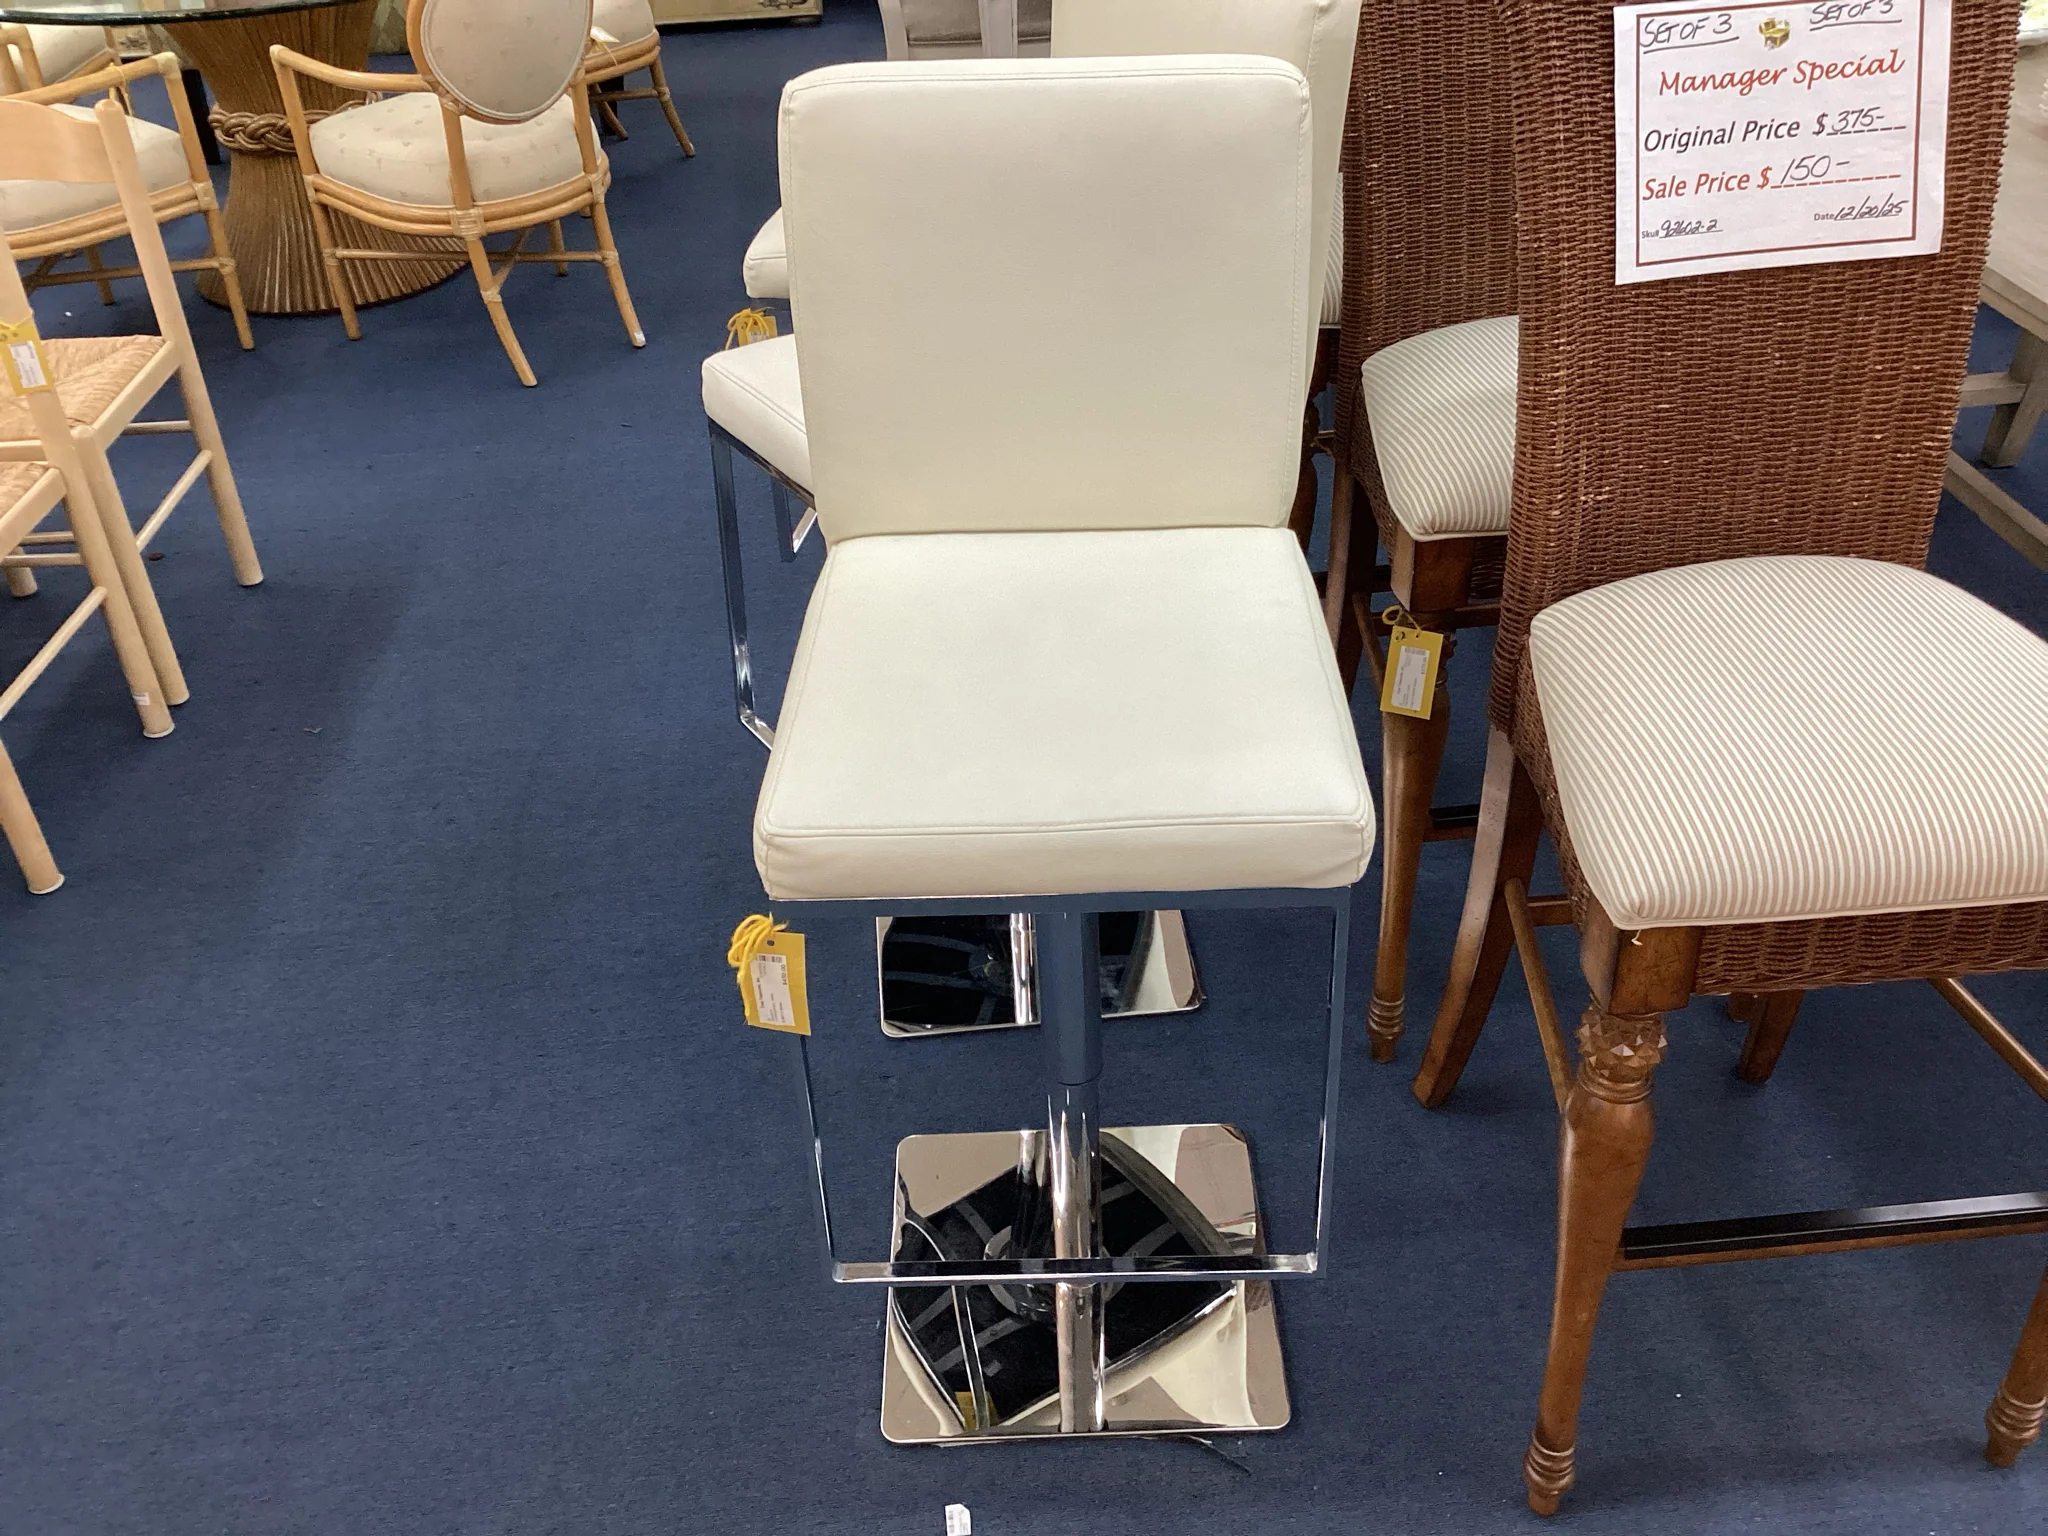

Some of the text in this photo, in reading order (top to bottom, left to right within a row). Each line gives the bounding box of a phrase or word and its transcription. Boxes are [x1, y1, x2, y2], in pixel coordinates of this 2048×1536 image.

[1809, 2, 1850, 25] SET
[1847, 0, 1877, 18] OF
[1640, 13, 1732, 48] SET OF 3
[1659, 48, 1906, 96] Manager Special
[1643, 120, 1737, 154] Original
[1741, 118, 1801, 142] Price
[1642, 175, 1686, 201] Sale
[1694, 172, 1750, 195] Price
